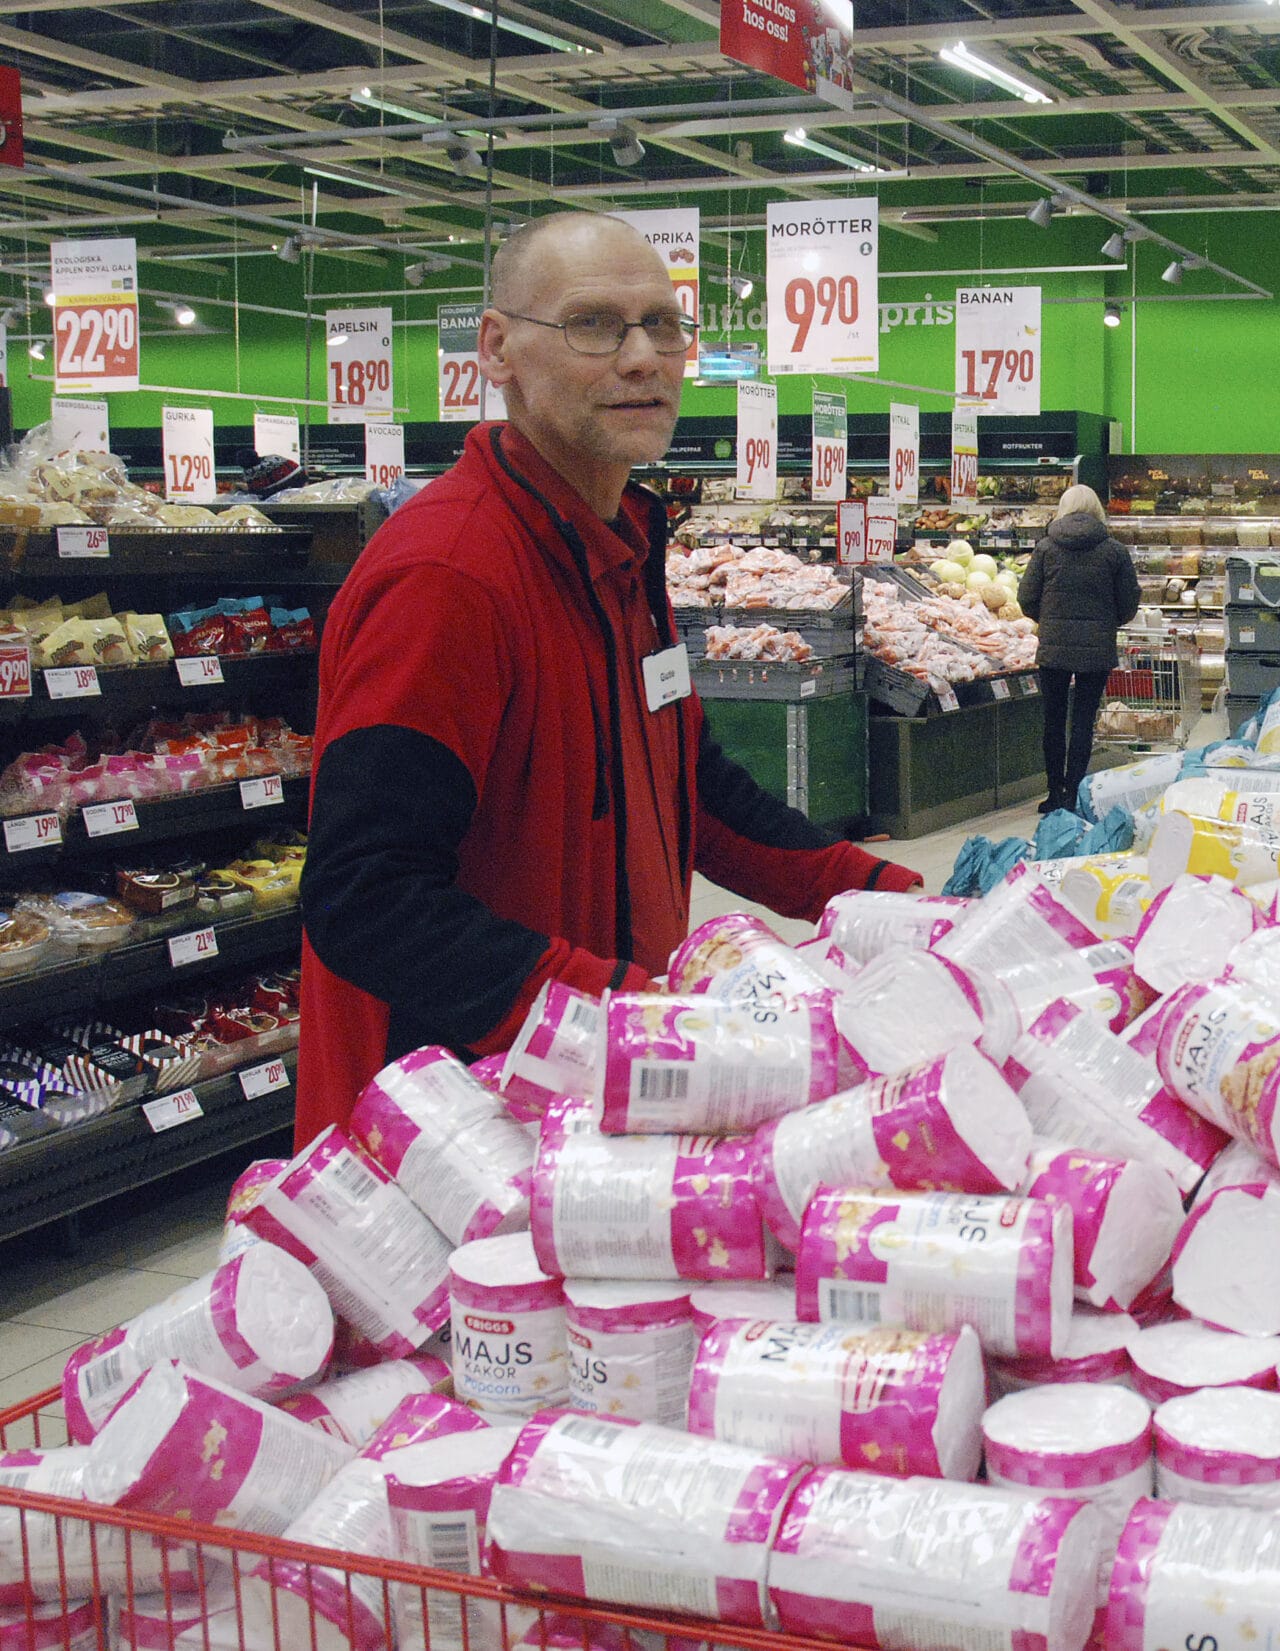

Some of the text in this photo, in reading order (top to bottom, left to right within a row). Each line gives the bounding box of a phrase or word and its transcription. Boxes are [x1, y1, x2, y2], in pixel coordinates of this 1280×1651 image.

[774, 0, 796, 23] loss
[743, 4, 765, 30] hos
[767, 20, 789, 42] oss!
[772, 217, 872, 237] MORÖTTER
[644, 232, 694, 244] APRIKA
[85, 265, 109, 274] ROYAL
[112, 263, 133, 272] GALA
[960, 292, 1013, 304] BANAN
[879, 294, 956, 333] pris
[330, 322, 378, 333] APELSIN
[740, 385, 775, 398] MORÖTTER
[166, 411, 196, 422] GURKA
[368, 426, 401, 436] AVOCADO
[0, 660, 28, 691] 990
[1186, 1011, 1227, 1095] MAJS
[466, 1317, 511, 1334] FRIGGS
[456, 1333, 534, 1365] MAJS
[465, 1362, 516, 1379] KAKOR
[464, 1375, 521, 1395] Popcorn
